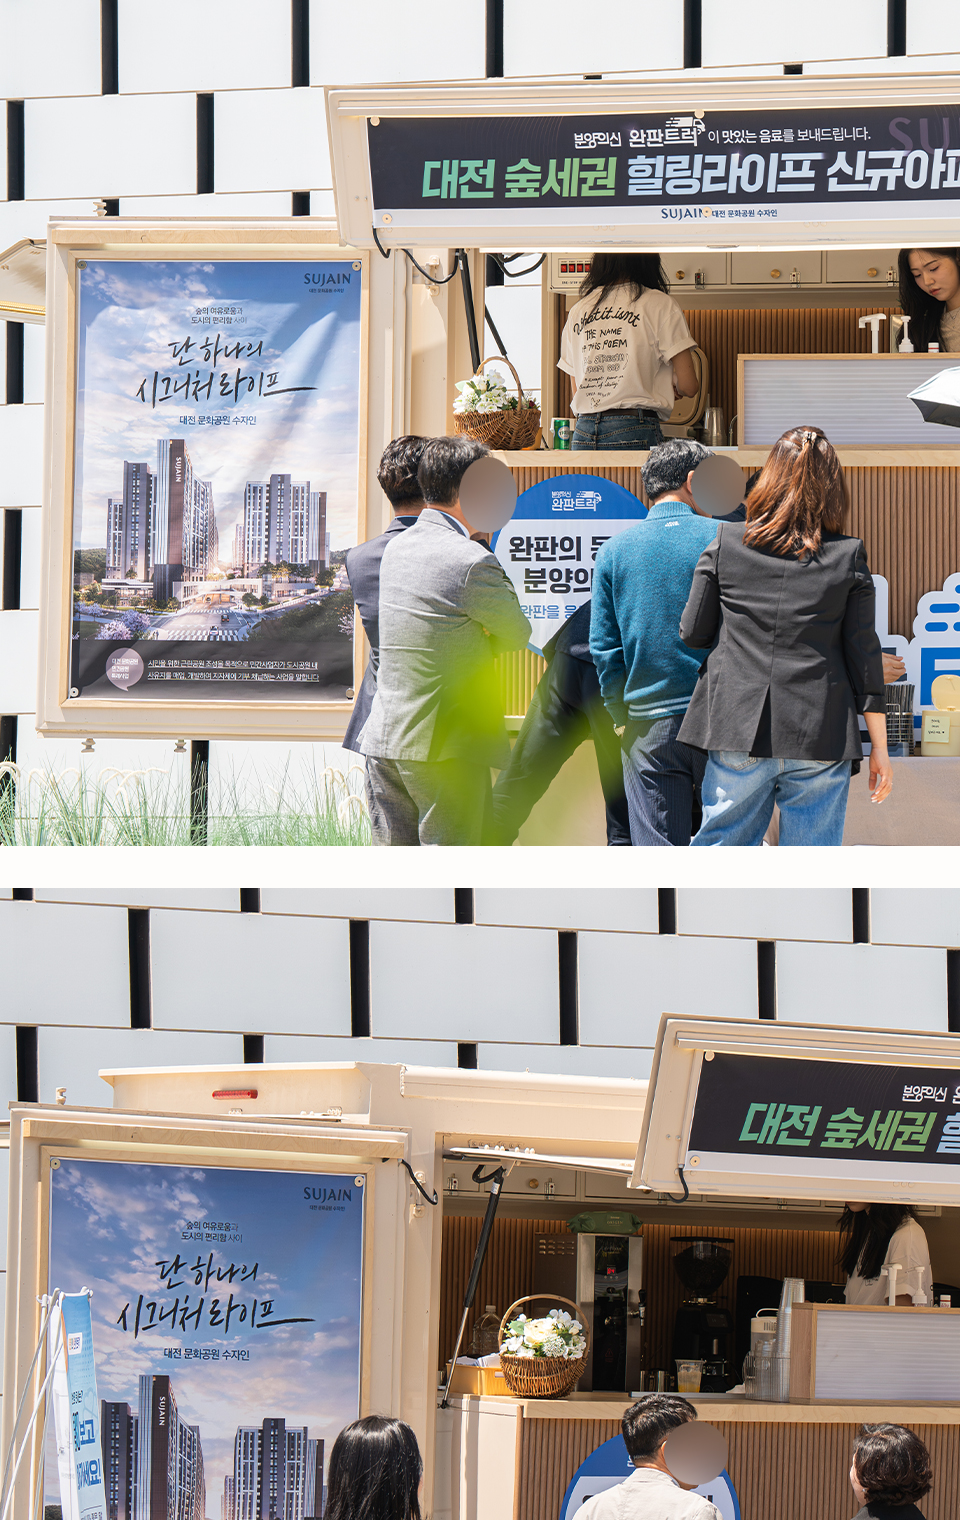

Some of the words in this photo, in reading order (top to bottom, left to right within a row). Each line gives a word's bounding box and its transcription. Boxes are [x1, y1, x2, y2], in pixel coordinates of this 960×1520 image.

[574, 131, 622, 149] 분양의신
[628, 127, 698, 148] 완판트럭
[708, 130, 720, 144] 이
[722, 129, 757, 144] 맛있는
[759, 128, 794, 143] 음료를
[797, 126, 872, 142] 보내드립니다.
[421, 158, 496, 199] 대전
[504, 156, 618, 198] 숲세권
[627, 153, 826, 196] 힐링라이프
[712, 209, 726, 219] 대전
[728, 208, 755, 218] 문화공원
[757, 208, 778, 218] 수자인
[303, 272, 351, 287] SUJAIN
[585, 329, 597, 341] THE
[600, 327, 623, 338] NAME
[168, 336, 198, 366] 단
[199, 334, 264, 367] 하나의
[587, 342, 601, 352] THIS
[602, 338, 628, 350] POEM
[136, 370, 214, 409] 시그니처
[218, 368, 318, 403] 라이프
[179, 415, 197, 426] 대전
[198, 415, 231, 426] 문화공원
[232, 415, 257, 426] 수자인
[552, 498, 597, 512] 완판트럭
[509, 535, 582, 562] 완판의
[524, 568, 592, 594] 분양의
[902, 1084, 948, 1104] 분양의신
[738, 1102, 822, 1147] 대전
[819, 1106, 938, 1153] 숲세권
[303, 1186, 352, 1203] SUJAIN
[186, 1221, 201, 1231] 숲의
[203, 1221, 239, 1232] 여유로움과
[181, 1231, 203, 1242] 도시의
[205, 1232, 227, 1243] 편리함
[227, 1233, 243, 1243] 사이
[155, 1253, 187, 1289] 단
[190, 1252, 259, 1293] 하나의
[117, 1294, 204, 1339] 시그니처
[209, 1293, 316, 1333] 라이프
[163, 1348, 182, 1360] 대전
[183, 1348, 220, 1361] 문화공원
[221, 1349, 250, 1361] 수자인
